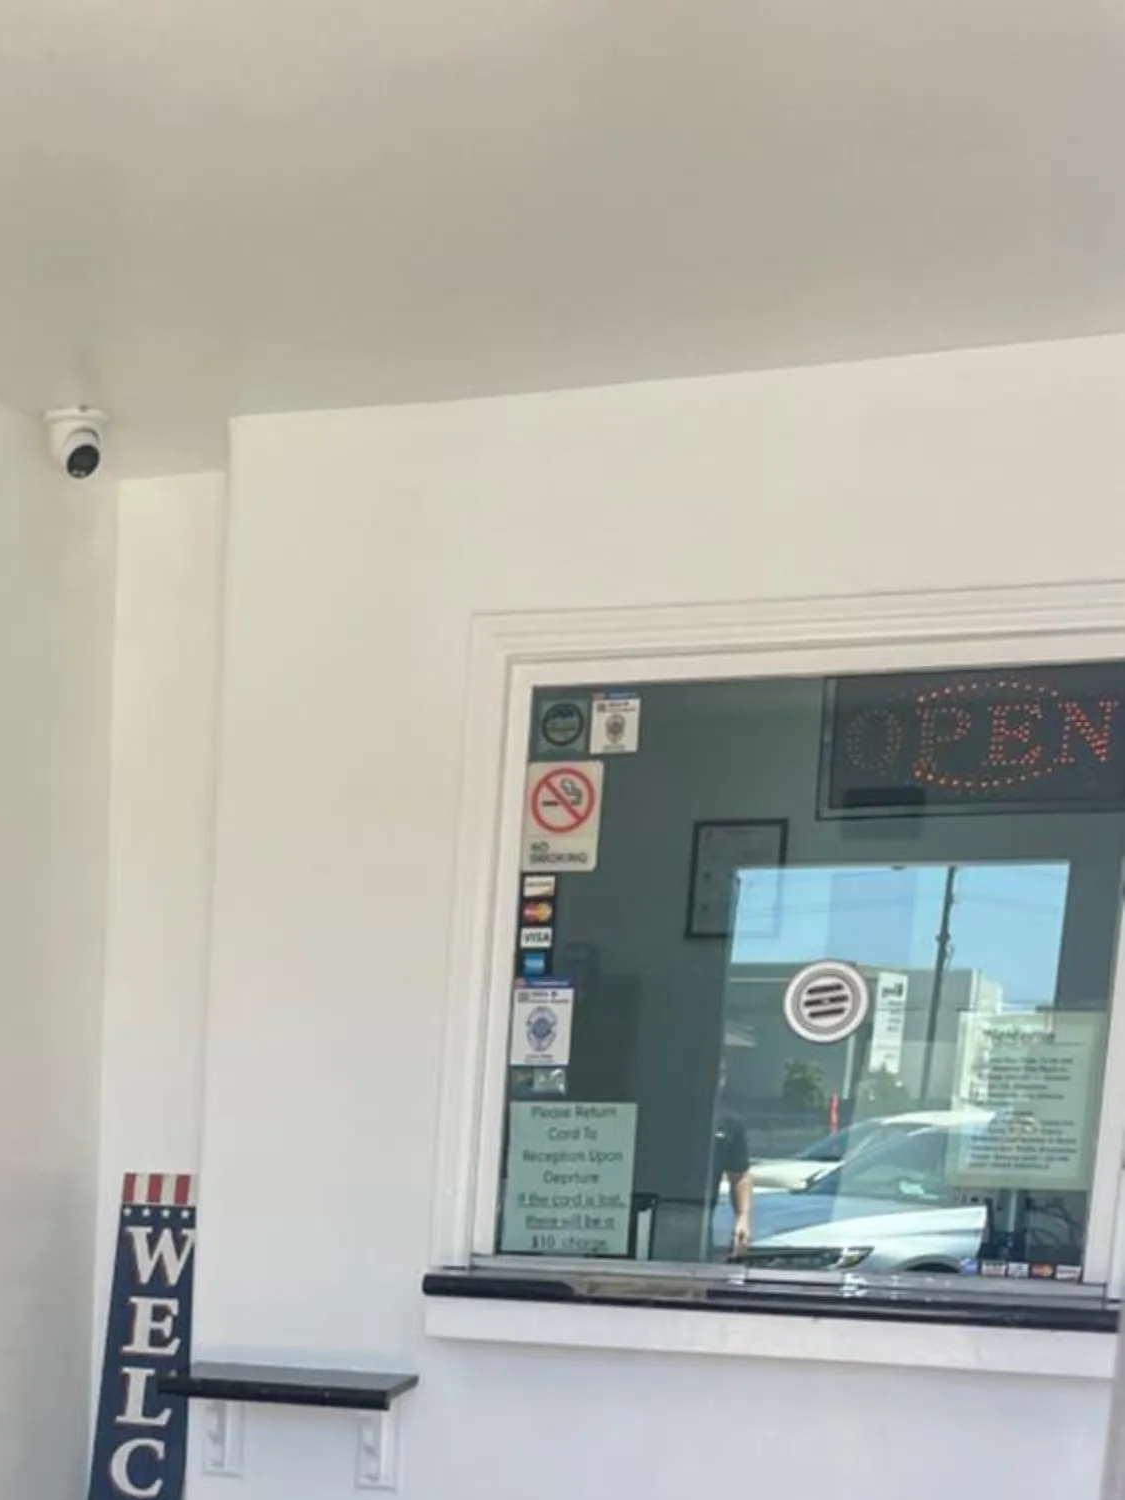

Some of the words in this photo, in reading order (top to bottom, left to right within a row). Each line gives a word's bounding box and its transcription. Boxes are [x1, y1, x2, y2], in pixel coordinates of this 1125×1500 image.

[846, 699, 1119, 770] OPEN
[530, 852, 588, 864] SMOKING
[525, 930, 549, 942] VISA
[531, 1106, 572, 1118] Please
[575, 1106, 617, 1119] Return
[548, 1126, 580, 1141] Card
[523, 1151, 585, 1166] Reception
[589, 1152, 623, 1166] Upon
[552, 1193, 583, 1206] card
